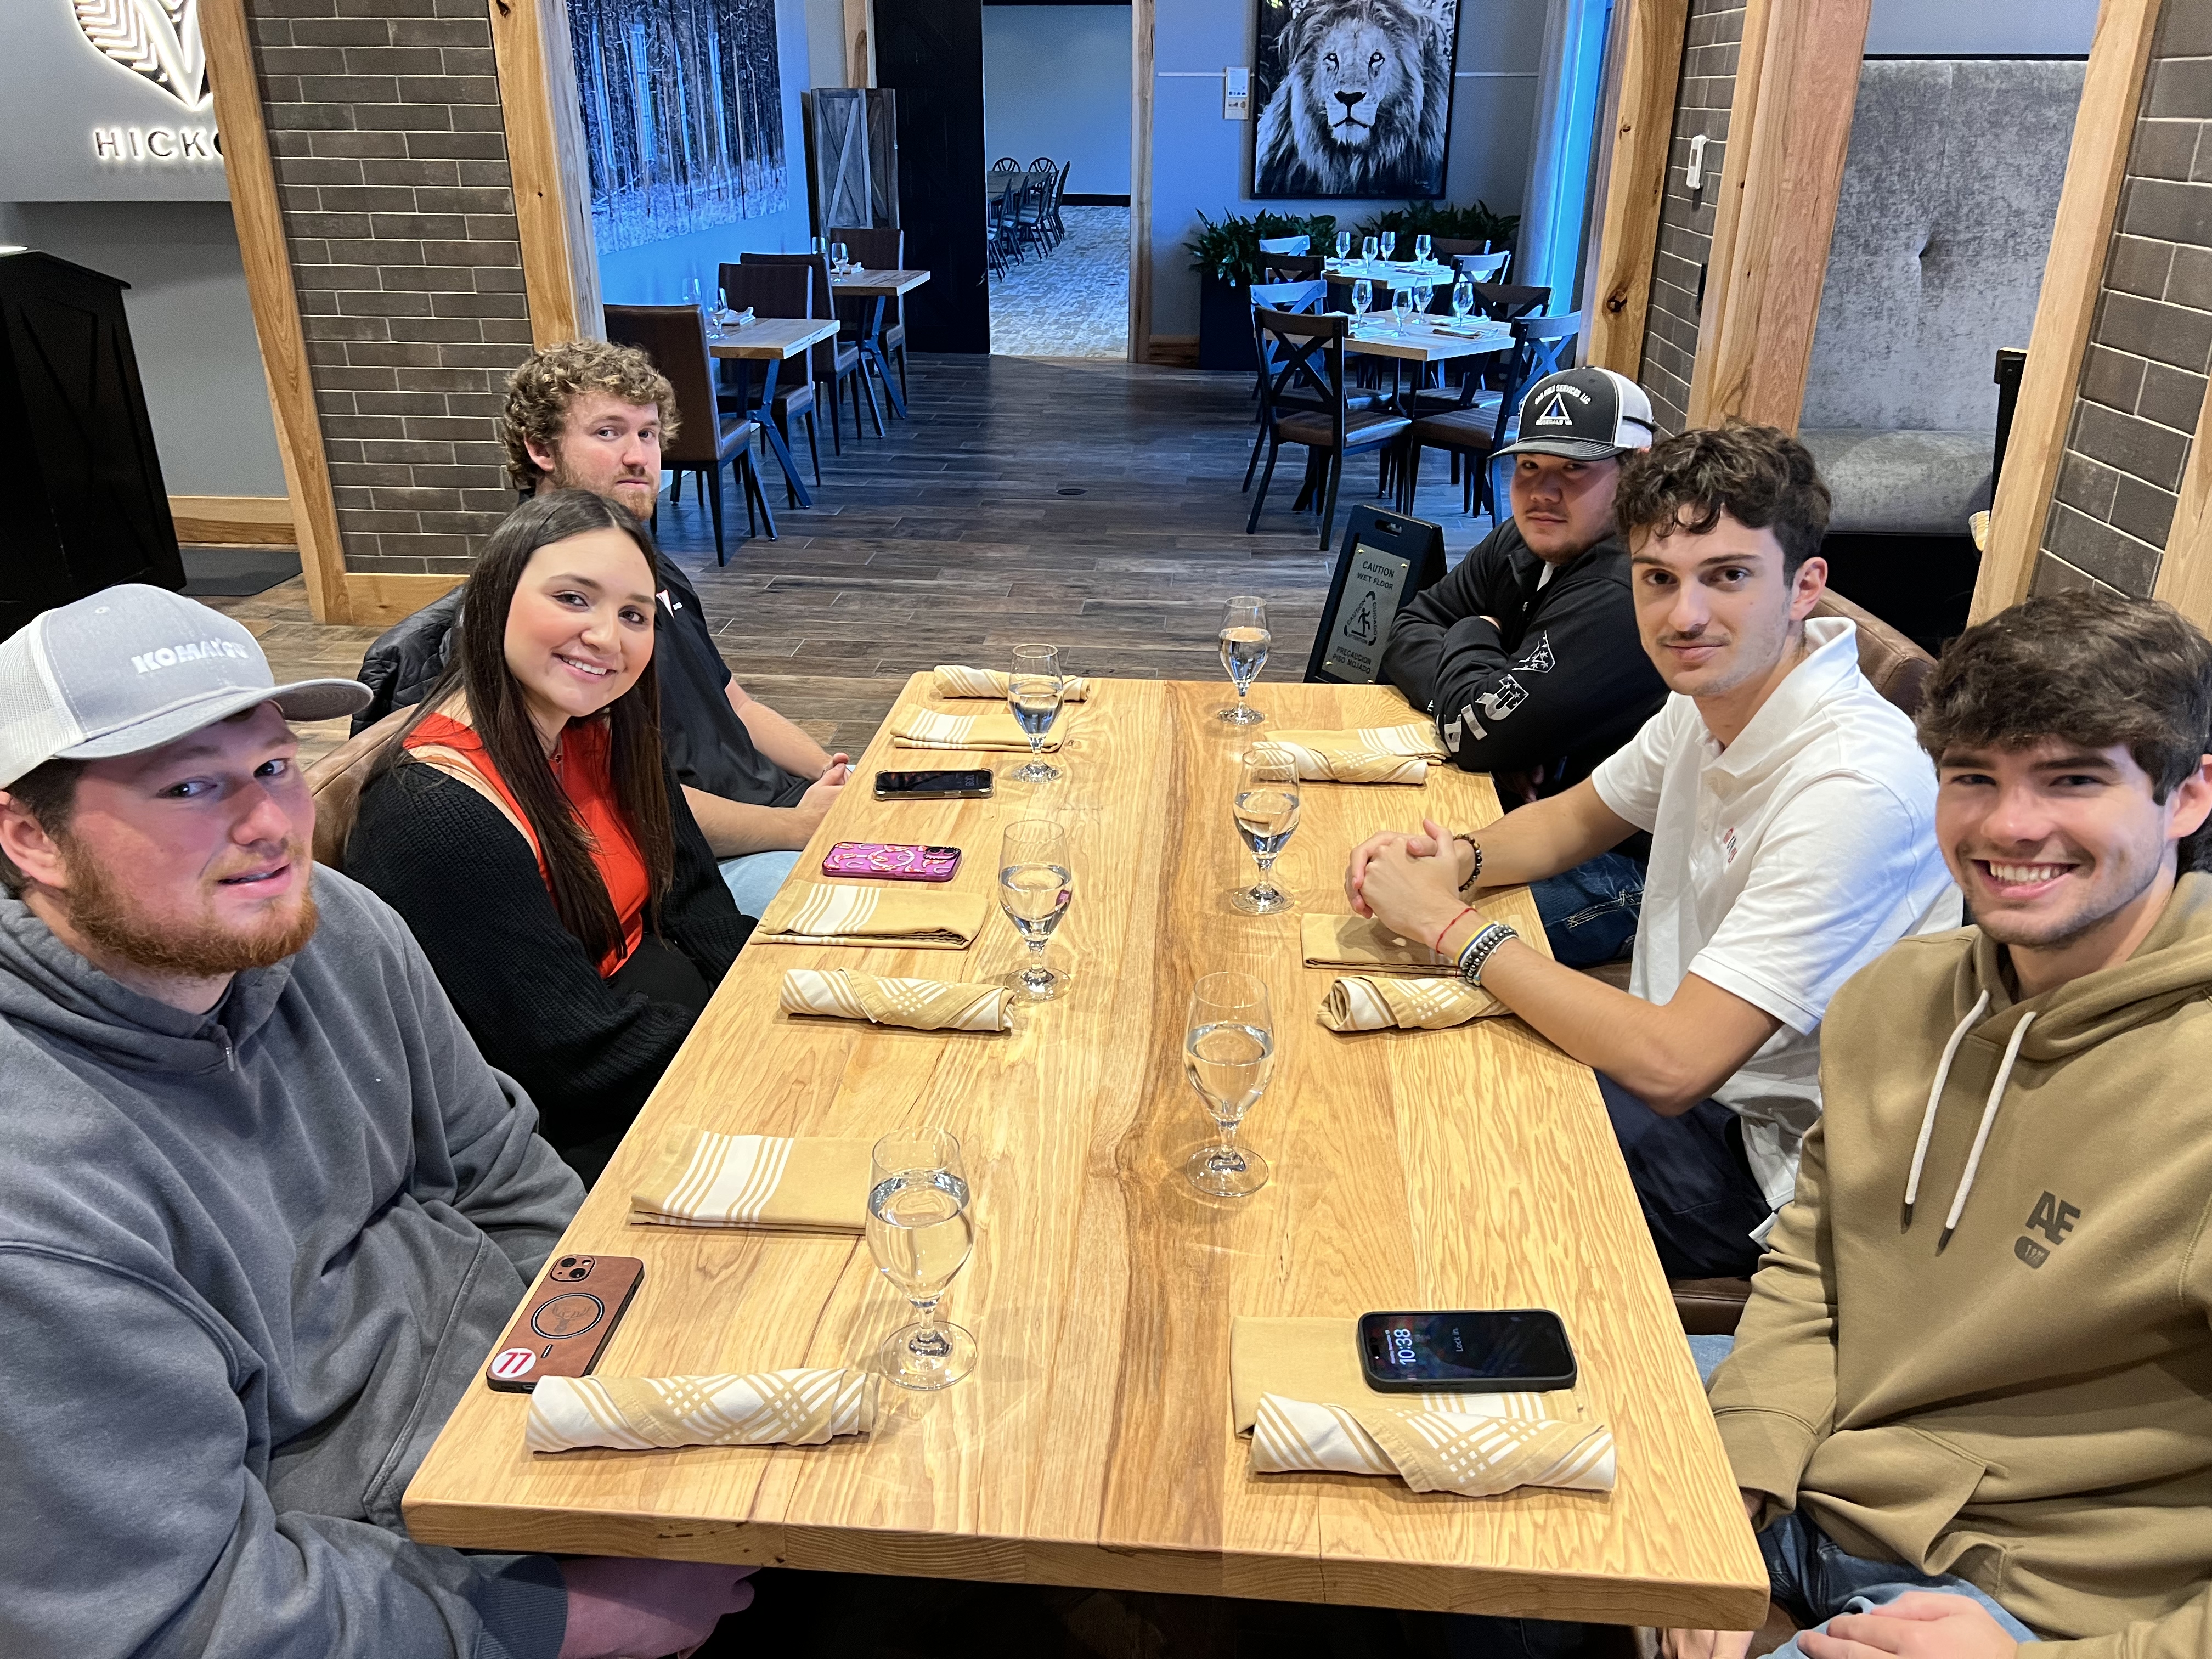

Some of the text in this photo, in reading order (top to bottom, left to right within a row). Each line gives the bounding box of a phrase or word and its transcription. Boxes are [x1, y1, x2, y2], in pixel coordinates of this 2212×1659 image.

[1579, 393, 1592, 405] LLC
[1362, 561, 1395, 579] CAUTION
[1357, 572, 1393, 591] WET FLOOR
[1347, 659, 1370, 674] MOJADO
[1393, 1329, 1417, 1365] 10:38
[1454, 1336, 1464, 1352] Lock
[497, 1352, 533, 1374] 77
